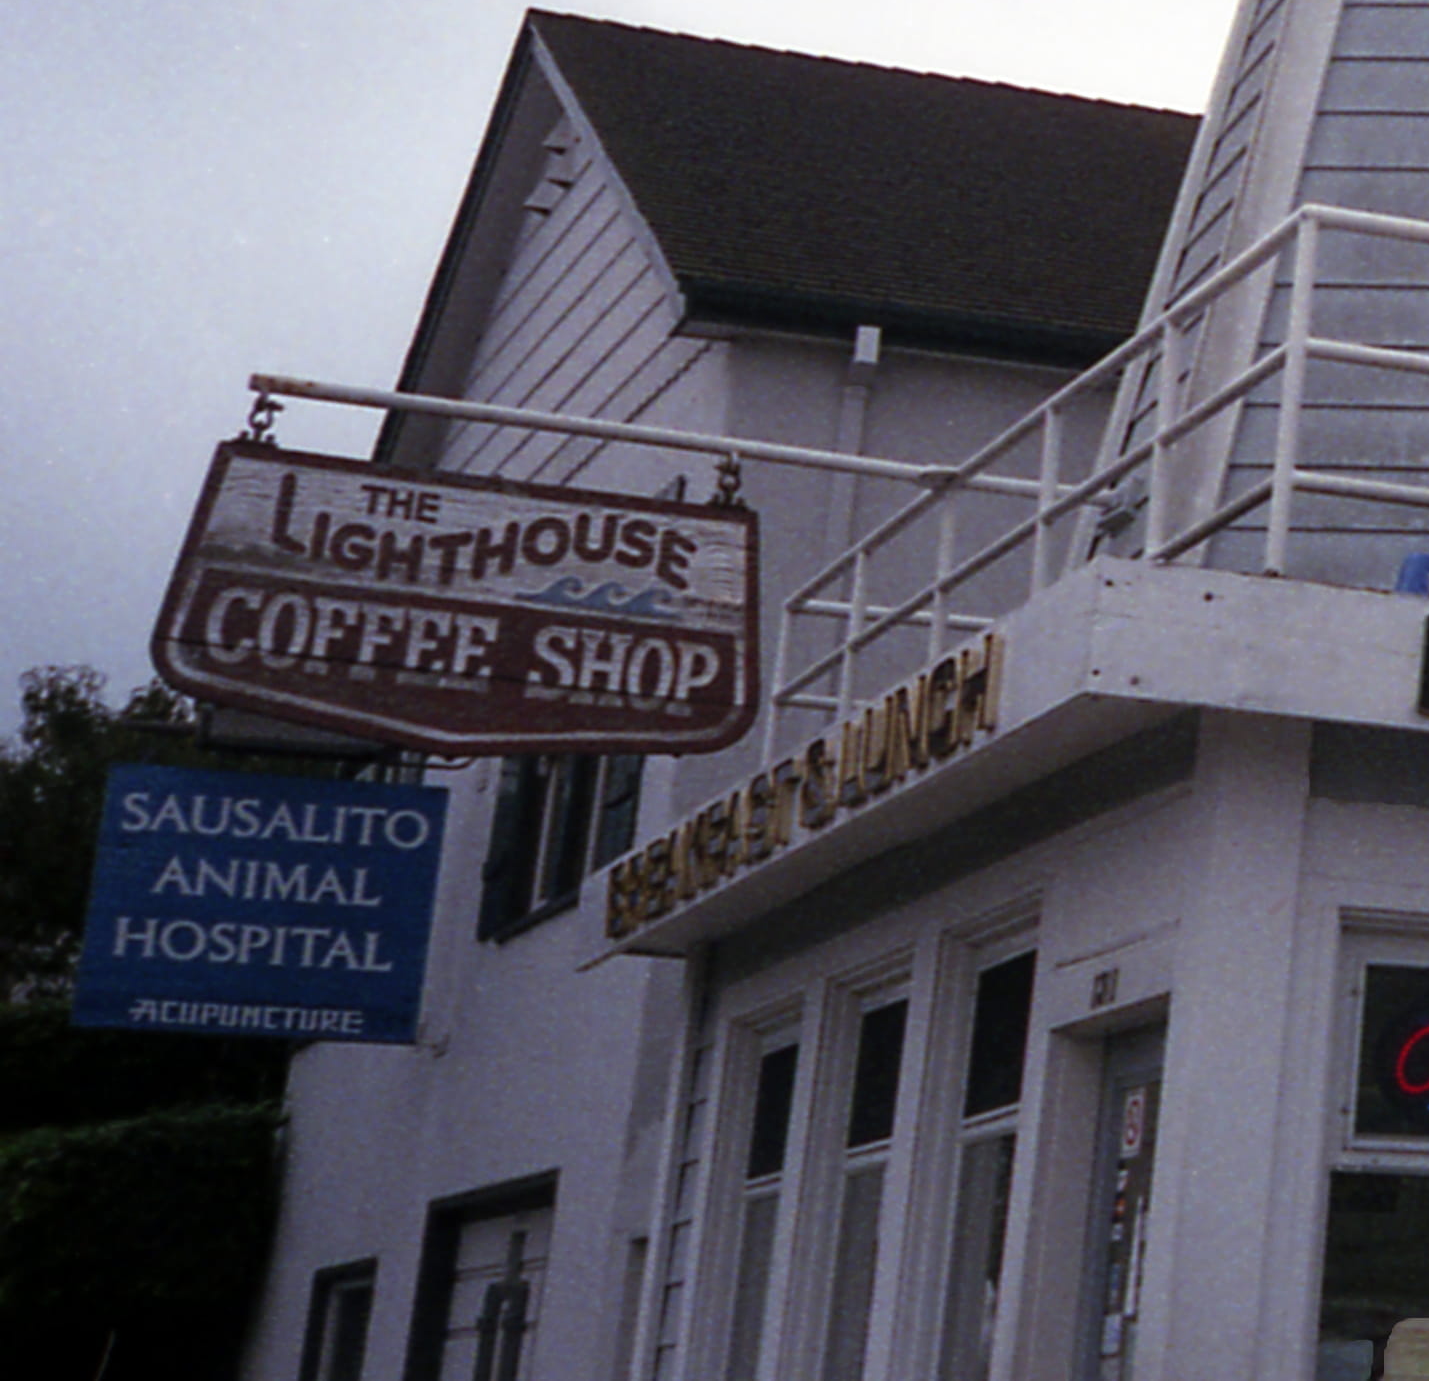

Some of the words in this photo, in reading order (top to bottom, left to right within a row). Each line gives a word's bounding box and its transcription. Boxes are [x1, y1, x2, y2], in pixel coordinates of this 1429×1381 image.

[271, 472, 697, 590] LIGHTHOUSE
[361, 484, 442, 524] THE
[204, 588, 499, 690] COFFEE
[525, 625, 721, 716] SHOP
[836, 633, 1000, 808] LUNCH
[121, 792, 430, 849] SAUSALITO
[151, 855, 382, 906] ANIMAL
[112, 917, 393, 972] HOSPITAL
[128, 998, 364, 1035] ACUPUNCTURE
